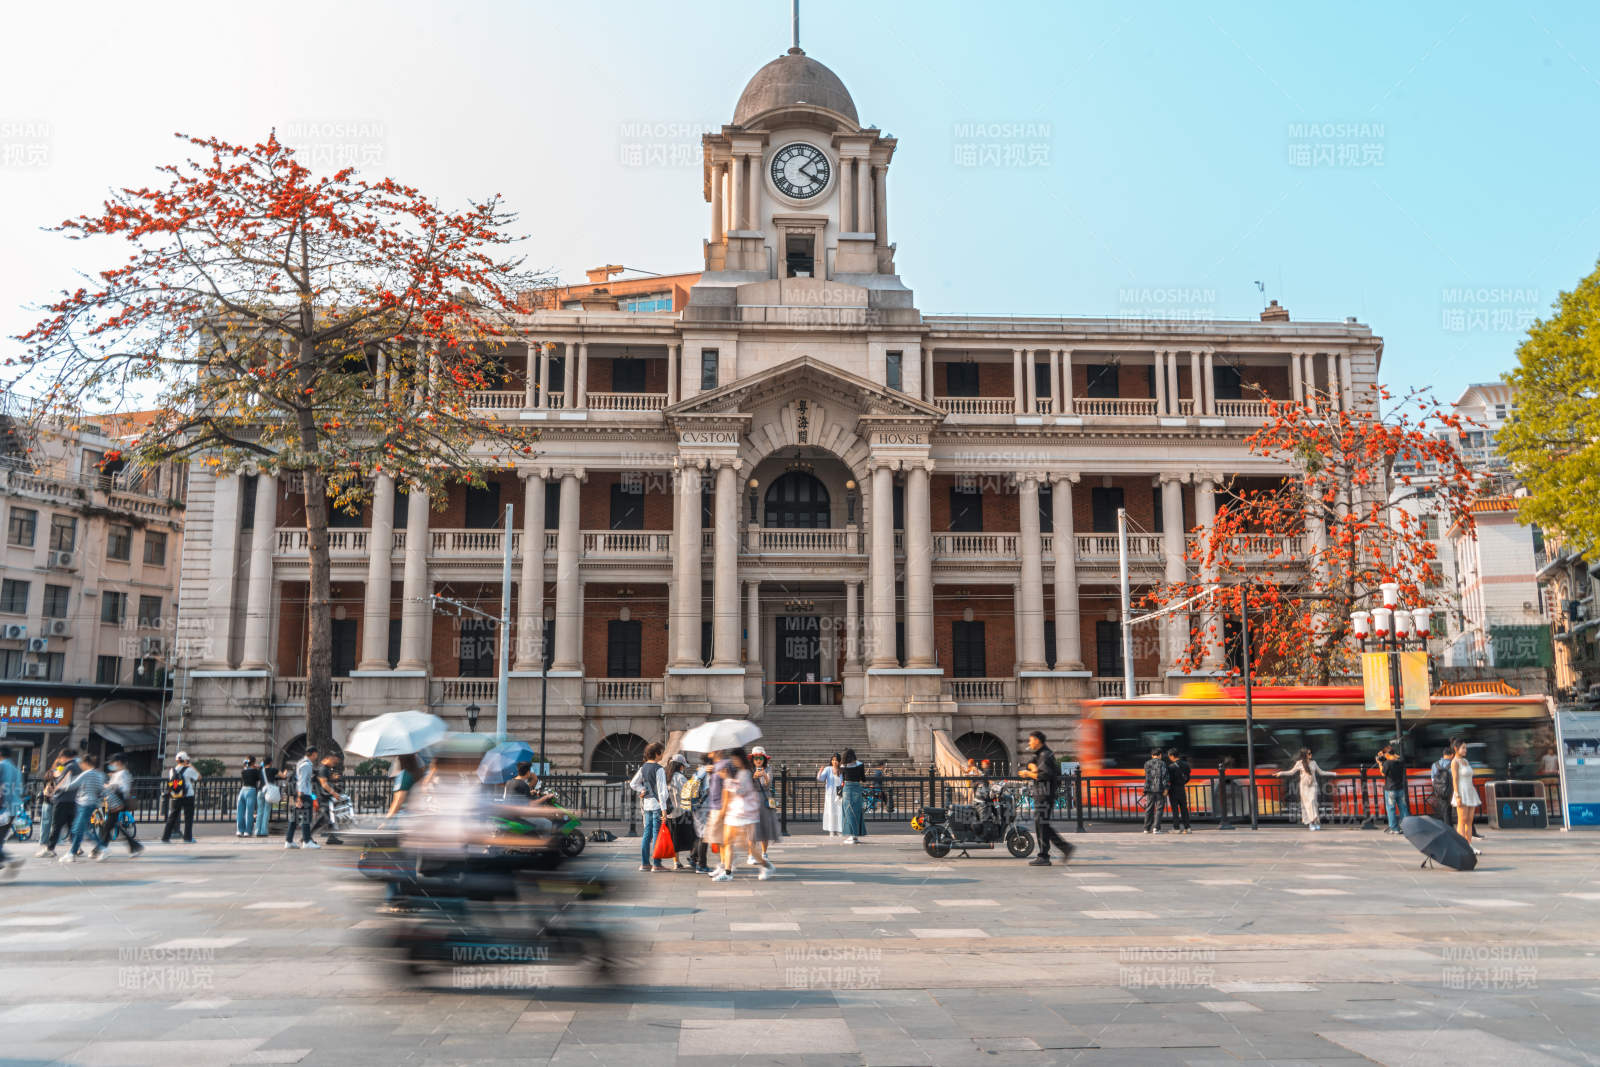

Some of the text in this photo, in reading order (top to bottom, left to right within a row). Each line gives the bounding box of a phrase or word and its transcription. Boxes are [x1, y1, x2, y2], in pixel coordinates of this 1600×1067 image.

[682, 432, 736, 443] CVSTOM
[879, 433, 922, 444] HOVSE
[16, 696, 49, 706] CARGO
